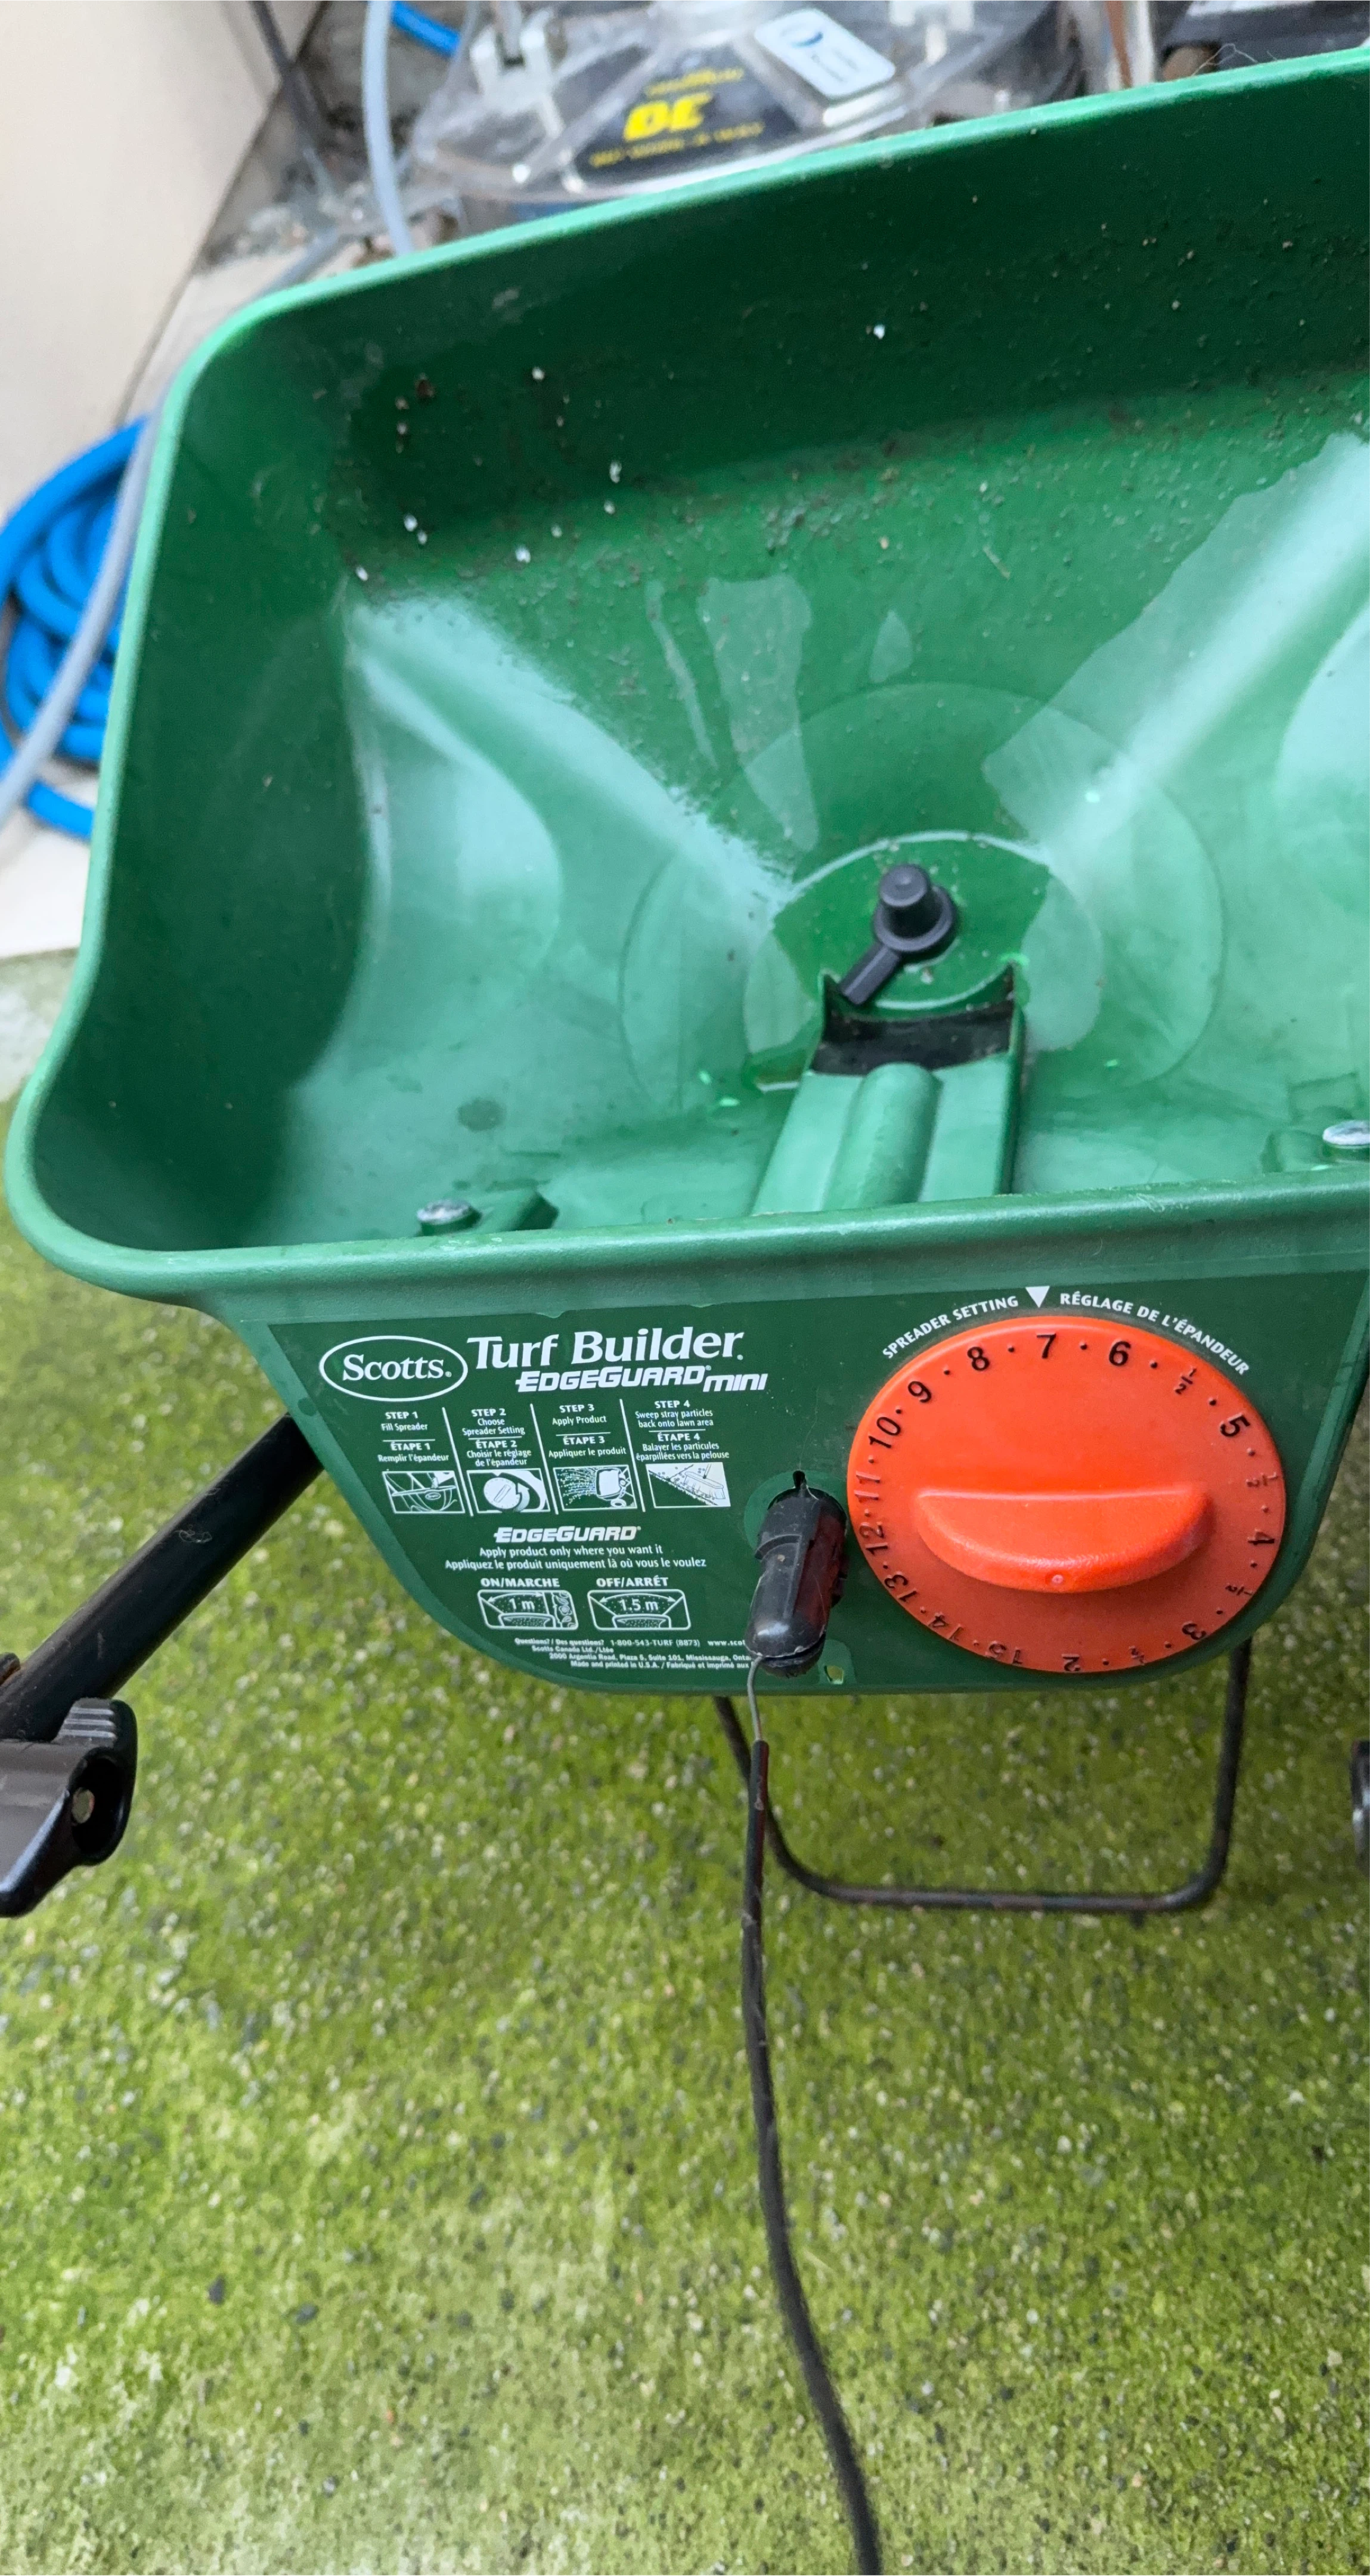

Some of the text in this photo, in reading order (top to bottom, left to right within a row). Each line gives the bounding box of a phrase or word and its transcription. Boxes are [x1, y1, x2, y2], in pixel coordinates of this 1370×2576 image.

[1060, 1292, 1133, 1314] RÉGLAGE
[1137, 1305, 1158, 1323] DE
[882, 1296, 1019, 1360] SPREADER SETTING
[467, 1334, 559, 1369] Turf
[1036, 1333, 1056, 1359] 7
[966, 1347, 990, 1371] 8
[1108, 1340, 1132, 1366] 6
[907, 1380, 933, 1404] 9
[559, 1405, 585, 1413] STEP
[655, 1400, 680, 1408] STEP
[635, 1408, 713, 1420] Sweep stray particles
[552, 1416, 607, 1426] Apply Product
[677, 1419, 695, 1427] lawn
[1220, 1413, 1250, 1438] 5
[395, 1423, 428, 1432] Spreader
[462, 1426, 525, 1436] Spreader Setting
[869, 1416, 902, 1450] 10
[563, 1435, 596, 1445] ÉTAPE
[657, 1432, 690, 1441] ÉTAPE
[390, 1442, 421, 1451] ÉTAPE
[475, 1439, 507, 1449] ÉTAPE
[642, 1444, 669, 1453] Balayer
[683, 1442, 719, 1451] particules
[378, 1454, 407, 1463] Remplir
[504, 1450, 531, 1459] réglage
[548, 1450, 586, 1459] Appliquer
[597, 1447, 626, 1456] produit
[636, 1452, 675, 1462] éparpillées
[701, 1451, 730, 1460] pelouse
[855, 1472, 882, 1504] 11
[859, 1522, 888, 1553] 12
[1248, 1530, 1275, 1546] 4
[479, 1544, 662, 1558] Apply product only where you want it
[445, 1557, 706, 1571] Appliquez le produit uniquement là où vous le voulez
[481, 1578, 560, 1588] ON/MARCHE
[884, 1572, 918, 1603] 13
[510, 1599, 535, 1610] 1 m
[620, 1599, 658, 1611] 1.5 m
[929, 1612, 960, 1642] 14
[1182, 1623, 1207, 1642] 3
[675, 1639, 701, 1648] (8873)
[985, 1640, 1023, 1664] 15
[1061, 1653, 1080, 1673] 2
